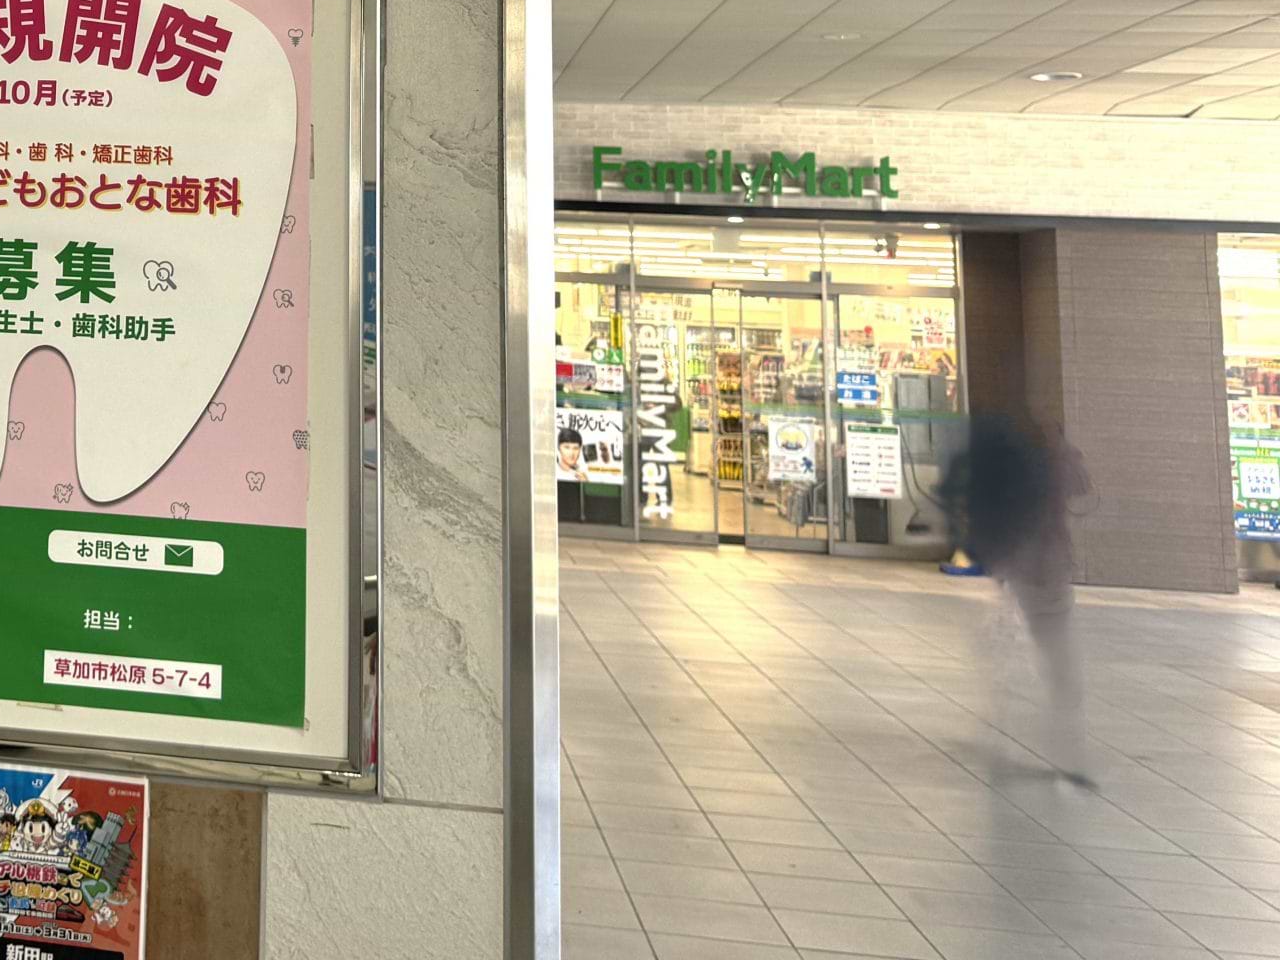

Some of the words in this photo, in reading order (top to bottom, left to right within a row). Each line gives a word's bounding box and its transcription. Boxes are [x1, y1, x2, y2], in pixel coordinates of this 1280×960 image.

[592, 146, 900, 201] FamilyMart
[637, 315, 678, 520] amilyMart
[76, 537, 150, 563] お問合せ
[83, 609, 134, 632] 担当:
[52, 657, 147, 686] 草加市松原
[151, 666, 212, 690] 5-7-4
